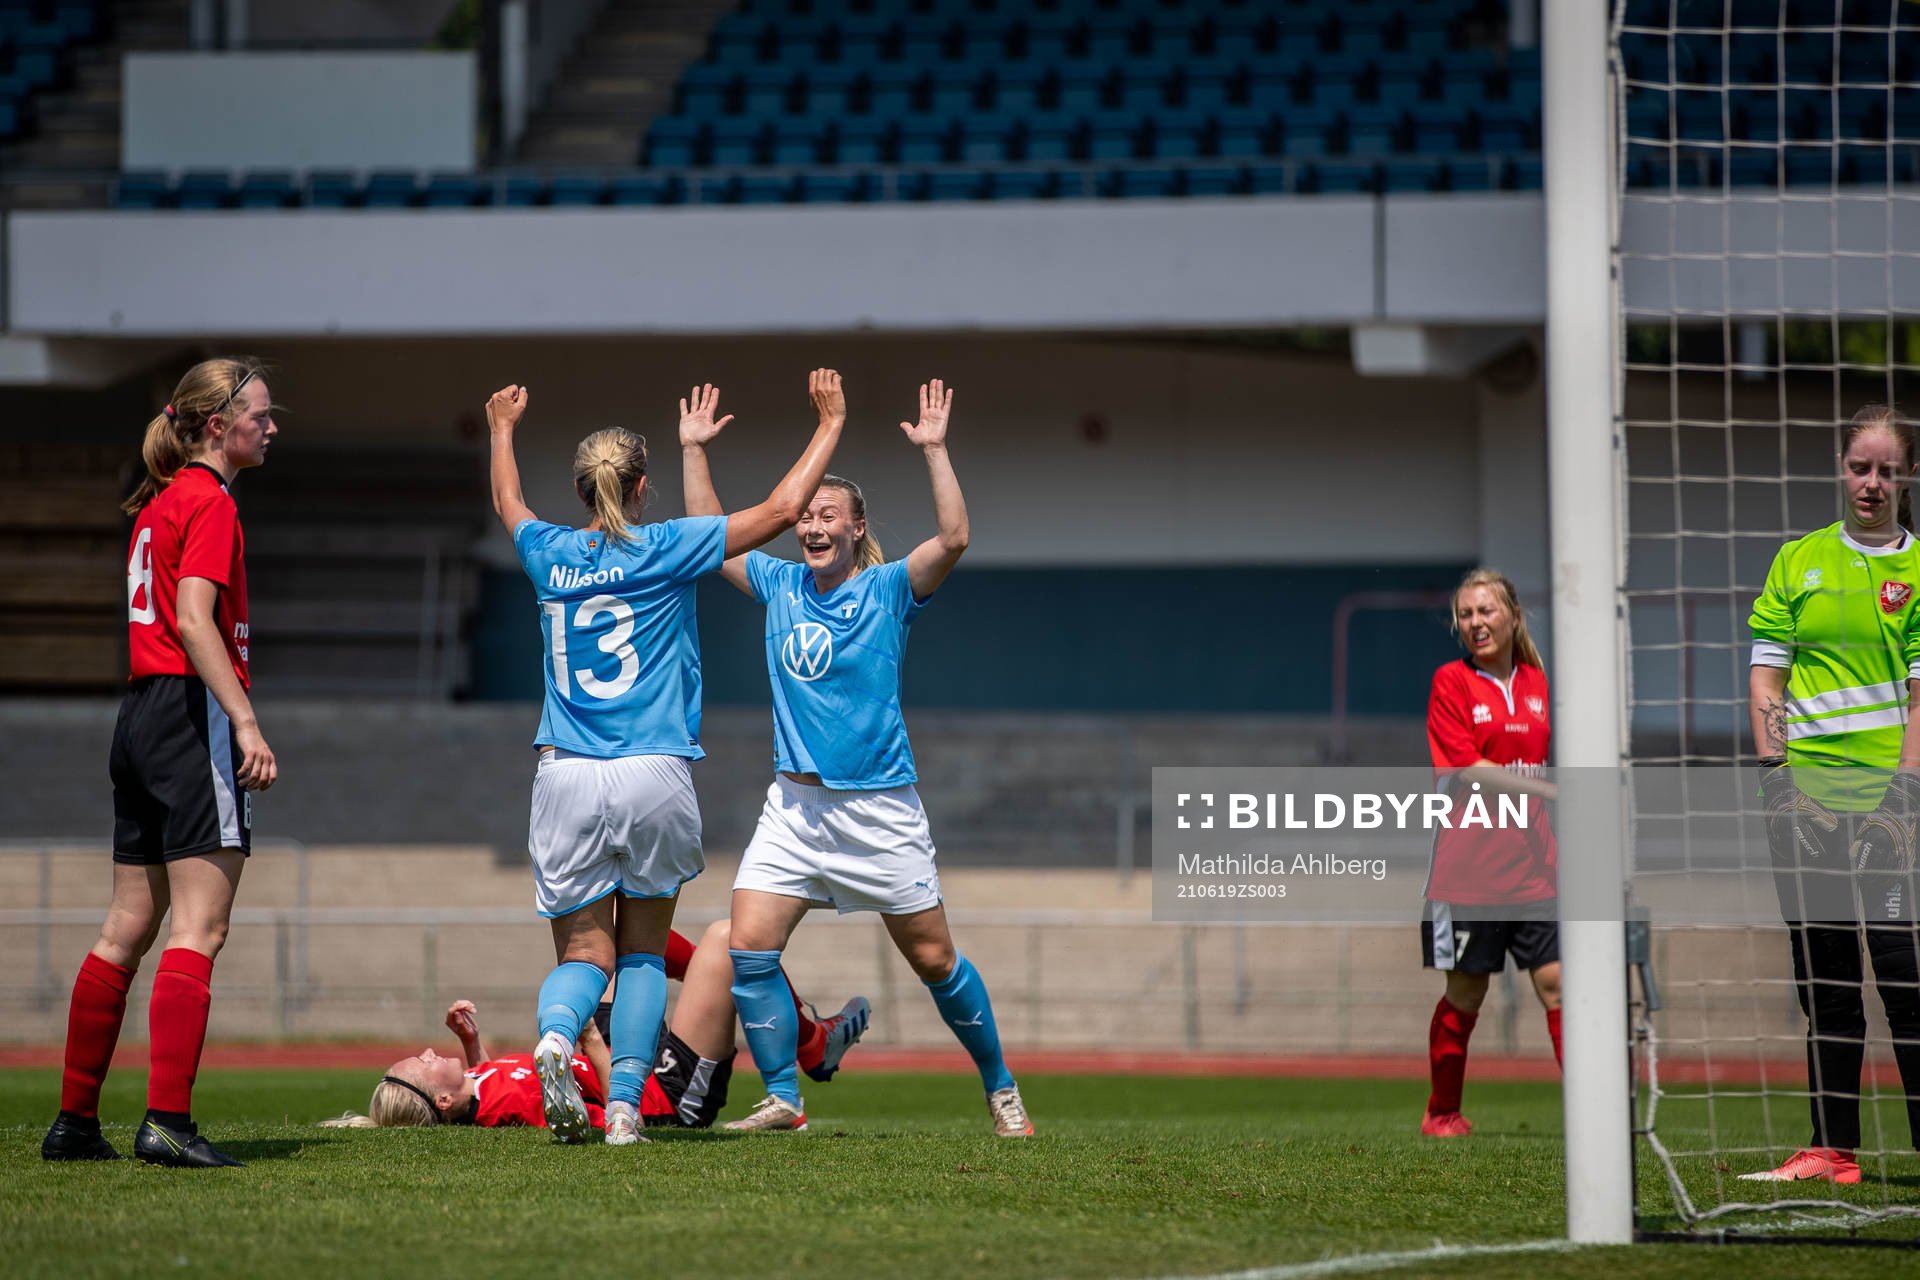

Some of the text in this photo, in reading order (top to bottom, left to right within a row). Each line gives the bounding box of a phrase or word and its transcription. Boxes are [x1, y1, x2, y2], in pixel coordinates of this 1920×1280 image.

[548, 564, 625, 589] Nilsson
[543, 594, 640, 700] 13
[1455, 930, 1471, 963] 7
